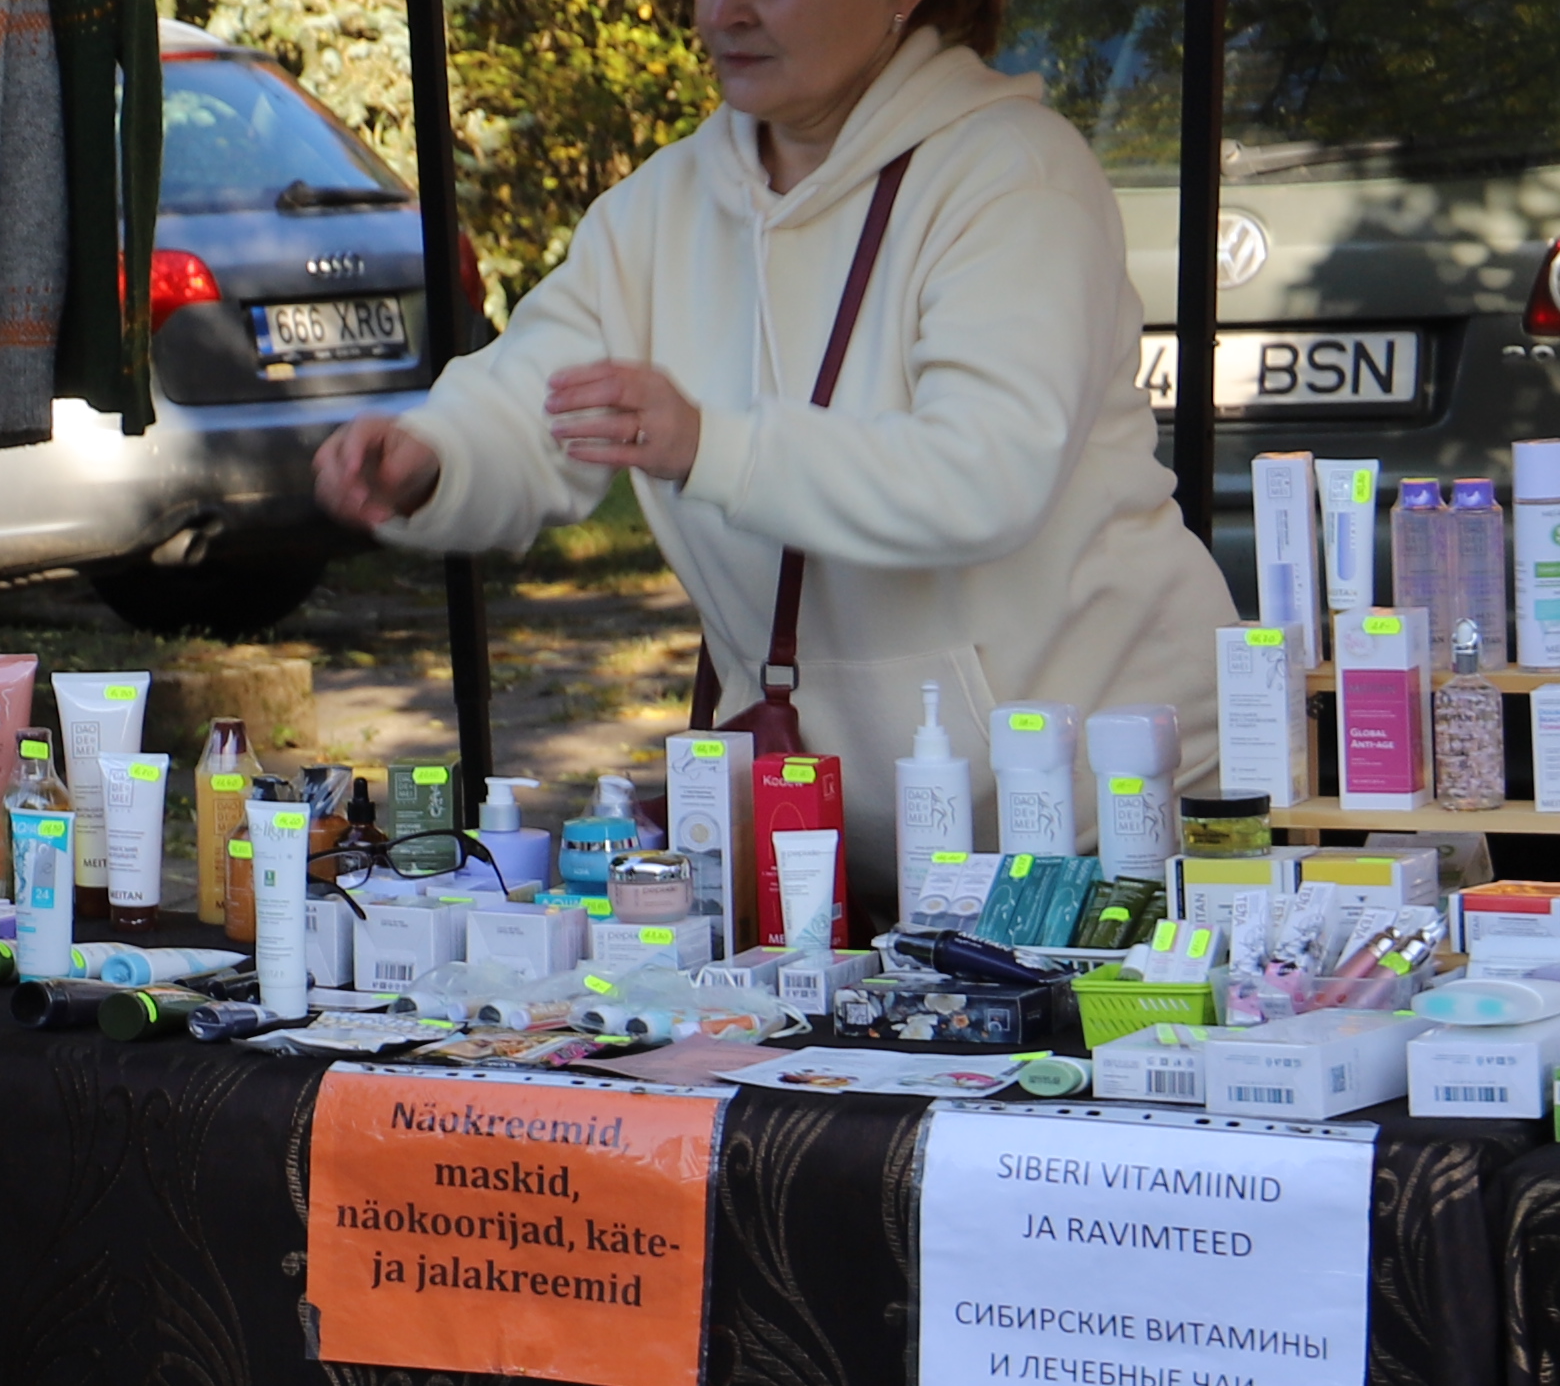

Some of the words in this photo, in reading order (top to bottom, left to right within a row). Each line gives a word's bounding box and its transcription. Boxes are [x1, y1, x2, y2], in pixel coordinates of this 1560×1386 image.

[275, 305, 326, 345] 666
[332, 300, 395, 342] XRG
[1257, 339, 1396, 397] BSN
[74, 724, 98, 736] DAO
[1349, 727, 1387, 739] GLOBAL
[74, 746, 97, 756] MEI
[907, 789, 932, 801] DAO
[1012, 795, 1038, 807] DAO
[1116, 797, 1142, 809] DAO
[907, 812, 930, 824] MEI
[1012, 818, 1038, 829] MEI
[1117, 821, 1142, 832] MEI
[34, 887, 51, 902] 24
[390, 1101, 632, 1154] Näokreemid,
[434, 1160, 581, 1204] maskid,
[996, 1152, 1091, 1187] SIBERI
[1100, 1161, 1283, 1203] VITAMIINID
[336, 1199, 577, 1254] näokoorijad,
[585, 1218, 681, 1258] käte-
[1021, 1213, 1058, 1241] JA
[1066, 1217, 1254, 1258] RAVIMTEED
[371, 1250, 406, 1290] ja
[415, 1253, 643, 1308] jalakreemid
[954, 1300, 1137, 1341] СИБИРСКИЕ
[1145, 1317, 1329, 1361] ВИТАМИНЫ
[989, 1352, 1011, 1378] И
